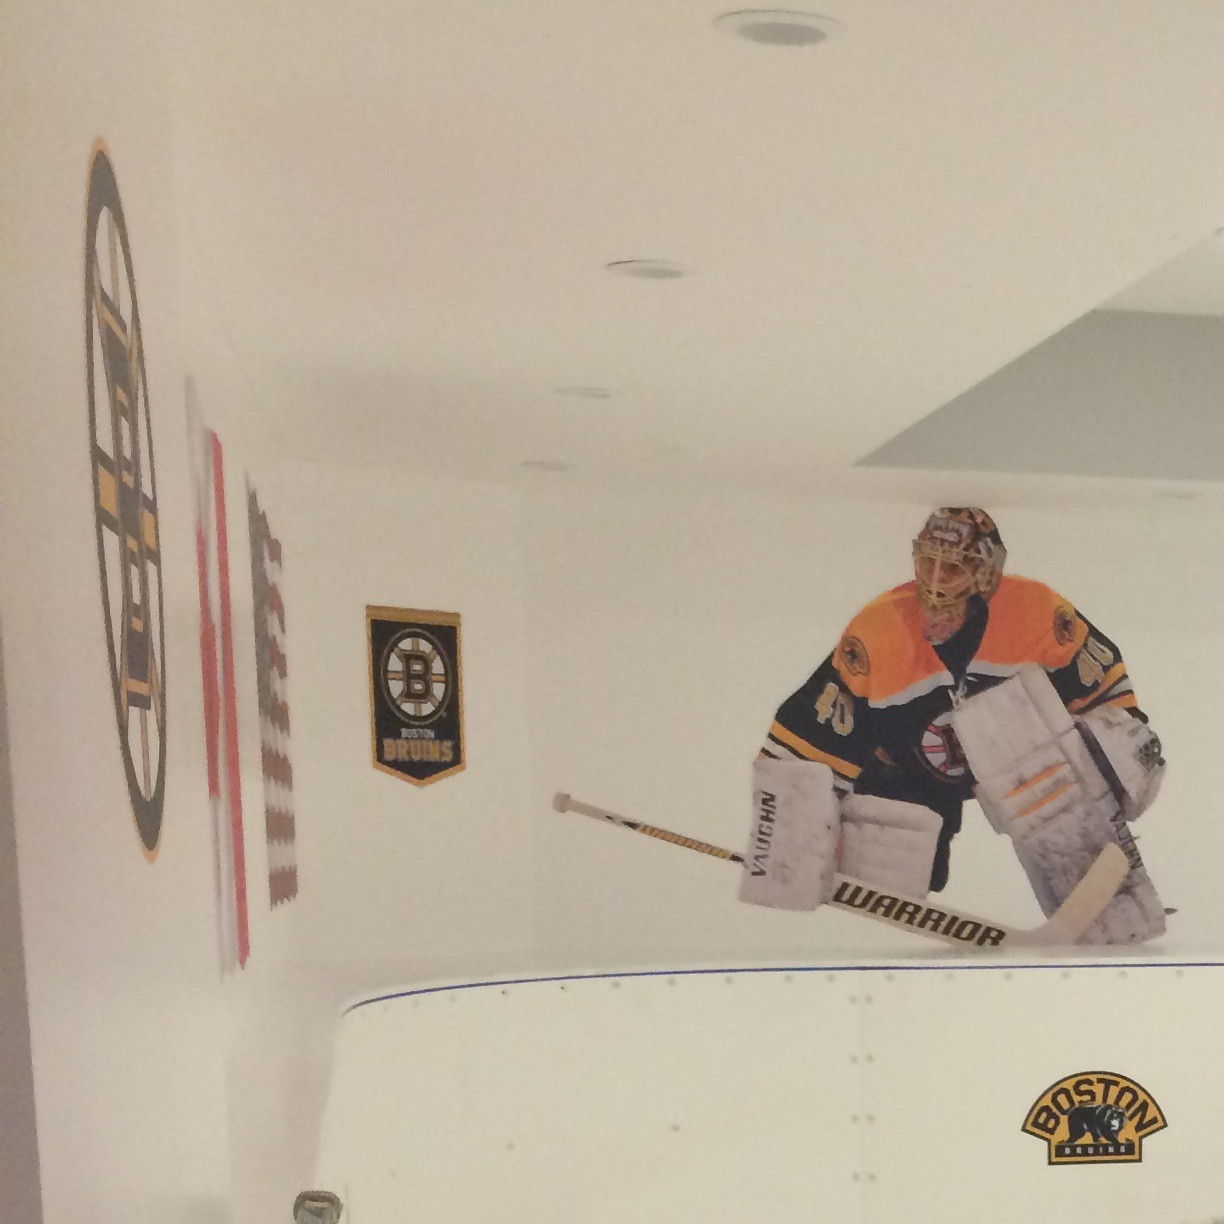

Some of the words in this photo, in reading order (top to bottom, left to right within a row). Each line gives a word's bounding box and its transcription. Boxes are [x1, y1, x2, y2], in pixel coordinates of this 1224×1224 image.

[751, 790, 777, 876] VAUGHN
[832, 881, 1006, 947] WARRIOR
[1031, 1077, 1158, 1135] BOSTON
